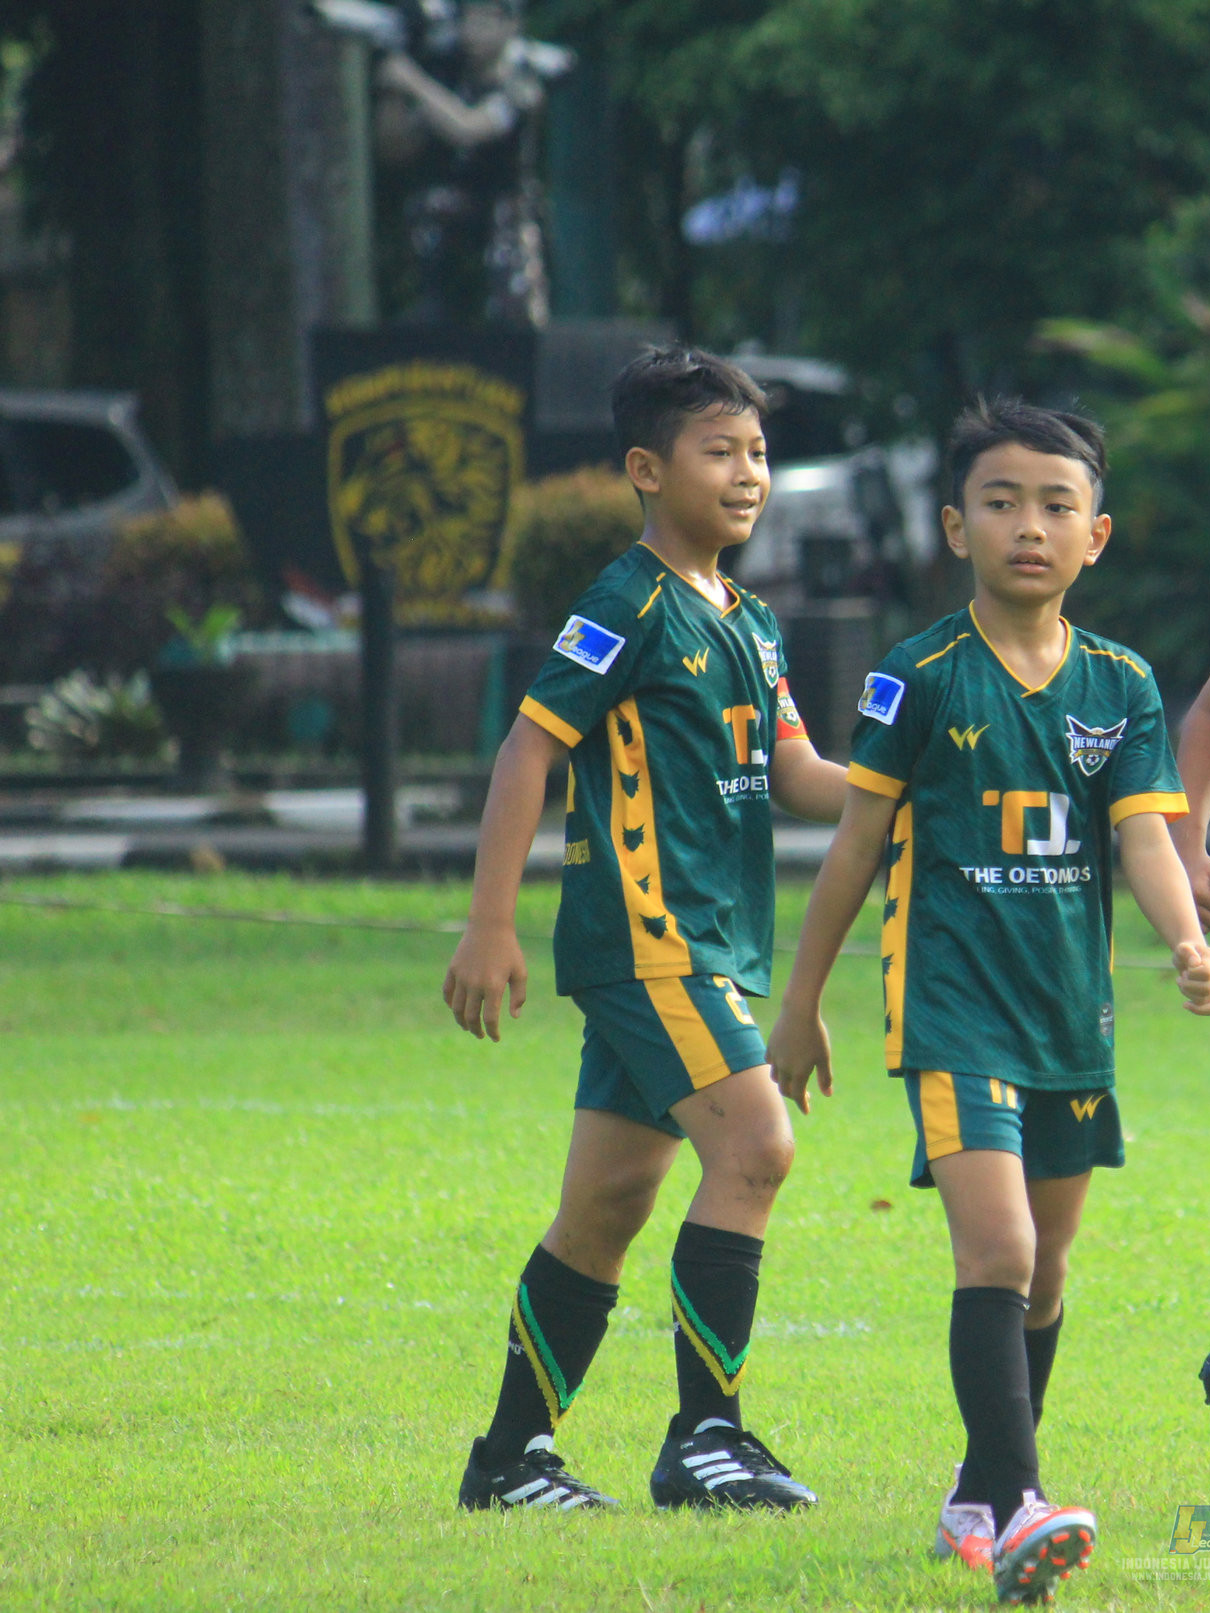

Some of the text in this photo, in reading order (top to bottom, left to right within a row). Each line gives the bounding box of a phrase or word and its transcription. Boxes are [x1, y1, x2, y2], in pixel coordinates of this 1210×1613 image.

[716, 778, 739, 795] THE
[959, 867, 1002, 884] THE
[713, 975, 755, 1025] 2
